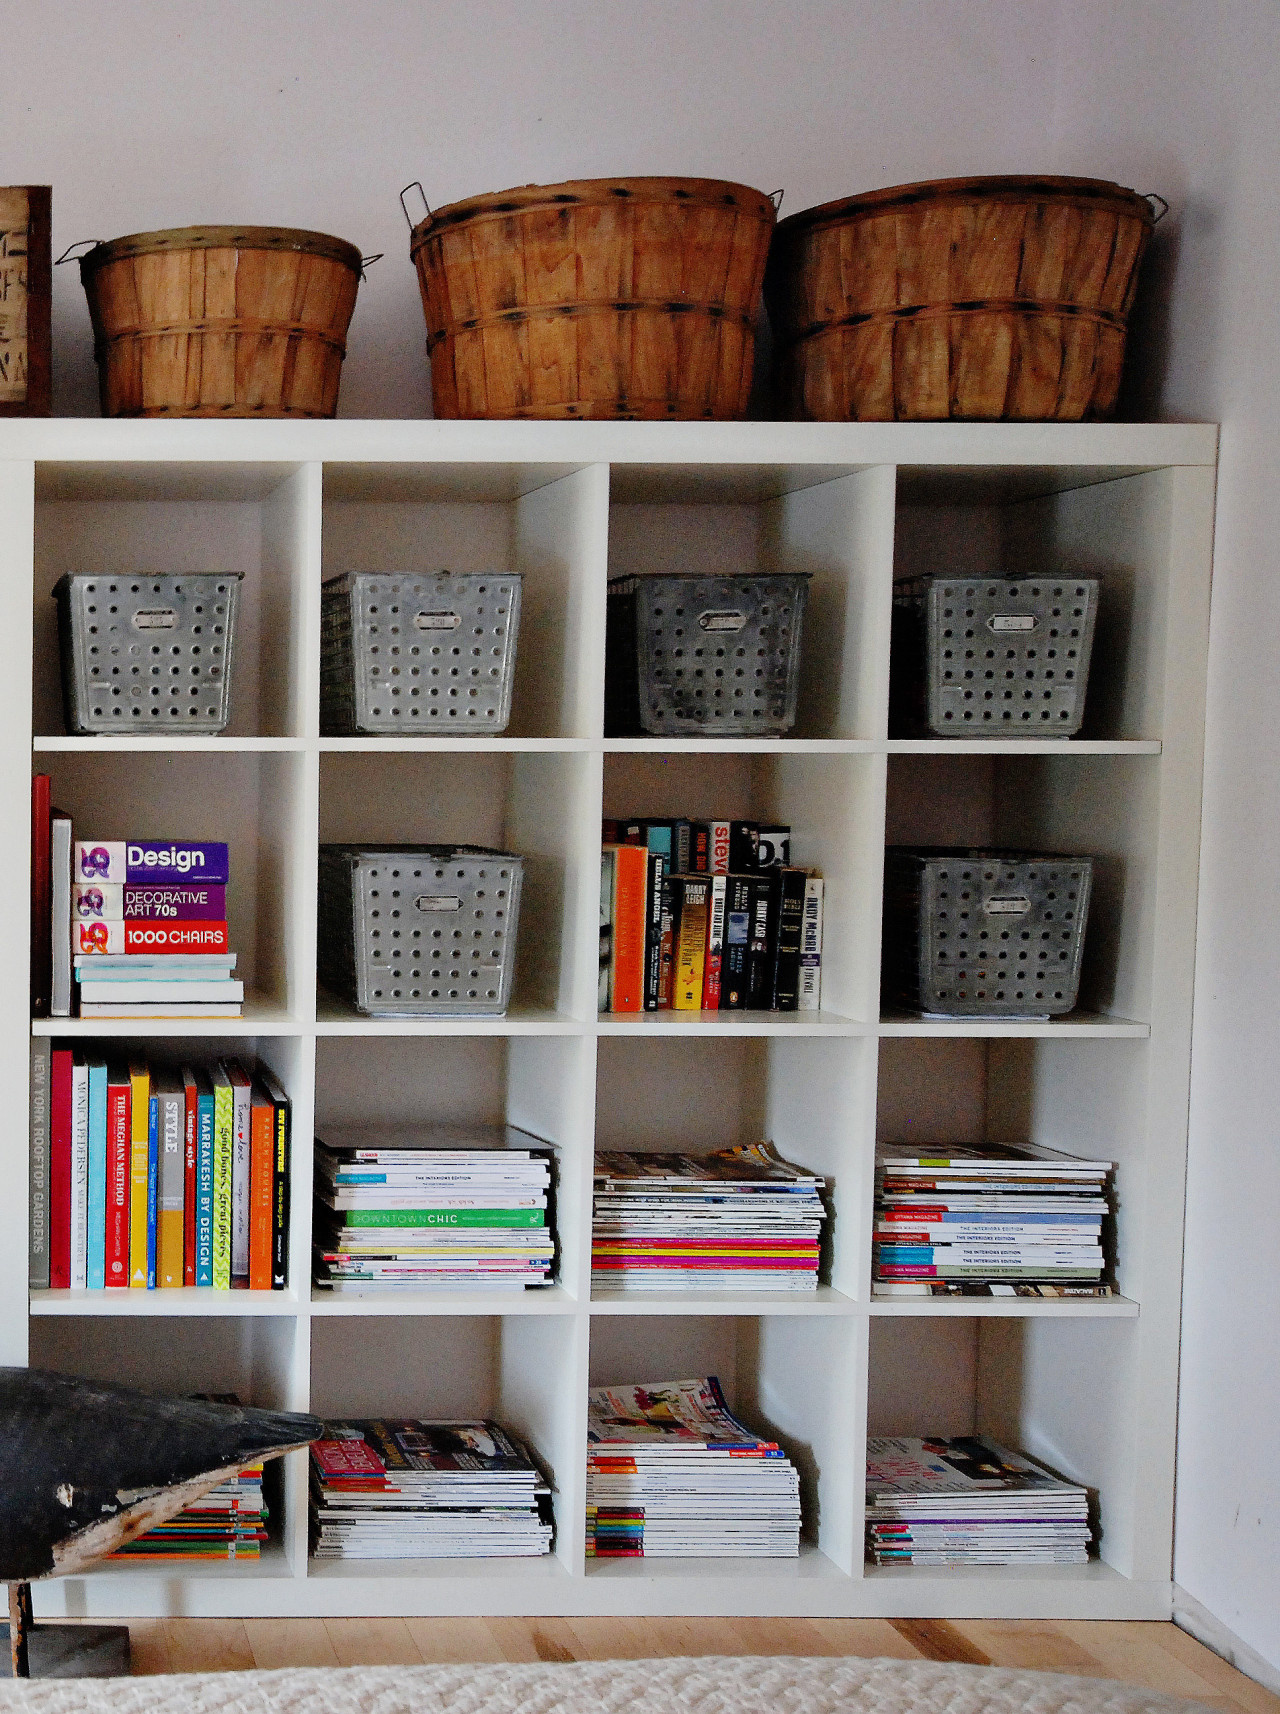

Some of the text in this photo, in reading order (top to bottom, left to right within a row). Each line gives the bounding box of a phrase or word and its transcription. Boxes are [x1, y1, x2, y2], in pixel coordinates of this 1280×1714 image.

[128, 846, 205, 872] Design
[714, 827, 730, 874] stev
[125, 905, 177, 916] ART 70s
[126, 892, 208, 904] DECORATIVE
[653, 892, 661, 923] ANGEL
[128, 931, 224, 943] 1000 CHAIRS
[76, 1081, 86, 1124] MONICA
[165, 1101, 178, 1153] STYLE
[186, 1110, 195, 1169] vintage style
[220, 1127, 230, 1153] good
[33, 1054, 44, 1253] NEW YORK ROOFTOP GARDENS
[76, 1128, 86, 1186] PEDERSEN
[115, 1095, 126, 1206] THE MEGHAN METHOD
[237, 1139, 247, 1164] love
[200, 1114, 212, 1266] MARRAKESH BY DESIGN
[219, 1193, 228, 1221] great
[353, 1215, 427, 1223] DOWNTOWN
[428, 1215, 458, 1223] CHIC
[218, 1224, 228, 1257] pieces
